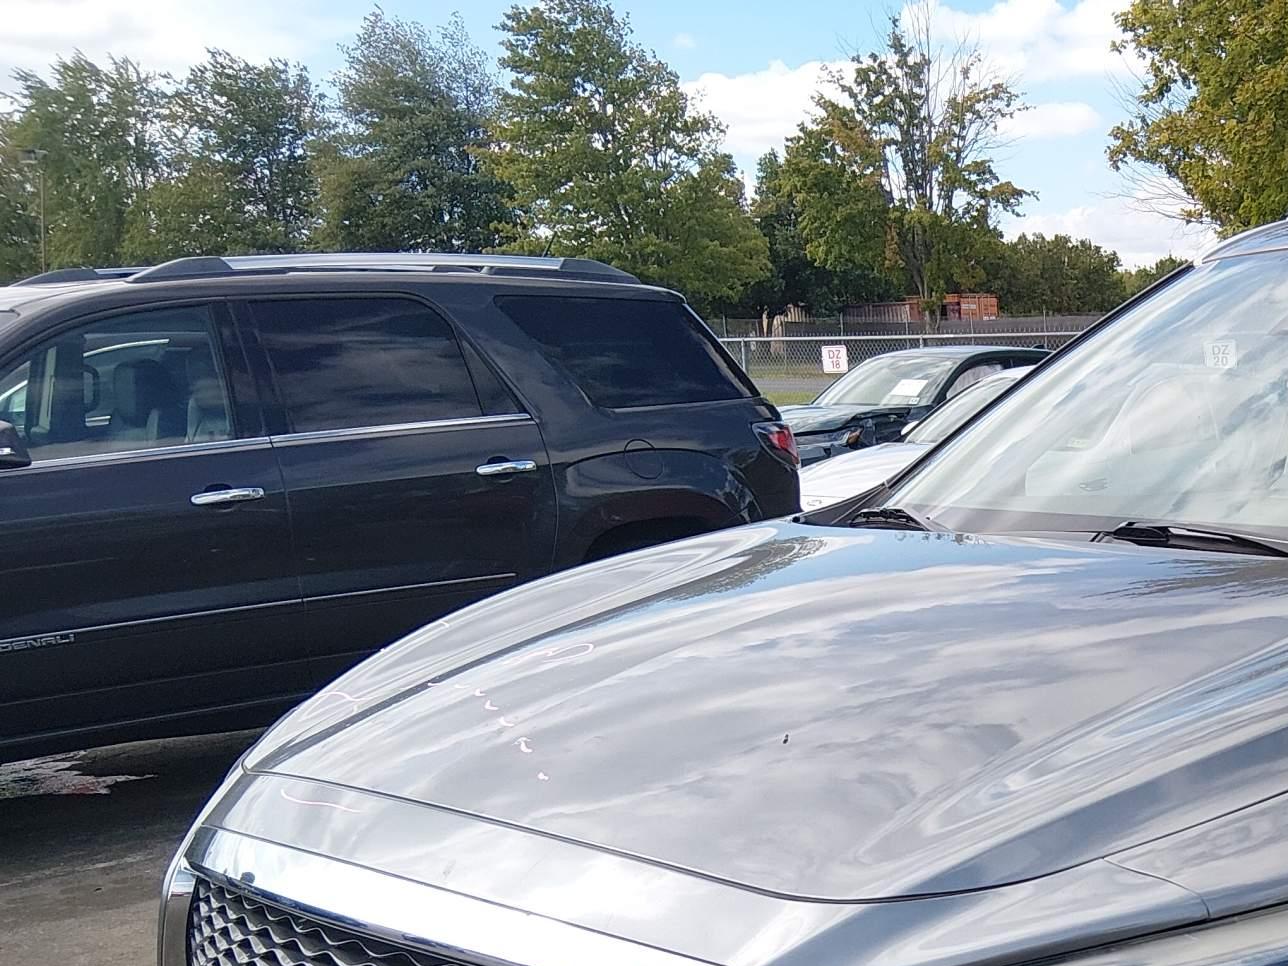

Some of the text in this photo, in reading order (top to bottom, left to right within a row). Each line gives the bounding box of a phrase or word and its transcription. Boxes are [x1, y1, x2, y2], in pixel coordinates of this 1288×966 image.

[827, 349, 842, 360] DZ
[1211, 344, 1230, 355] DZ
[831, 360, 841, 369] 18
[1213, 356, 1229, 367] 20
[0, 634, 75, 652] DENALI
